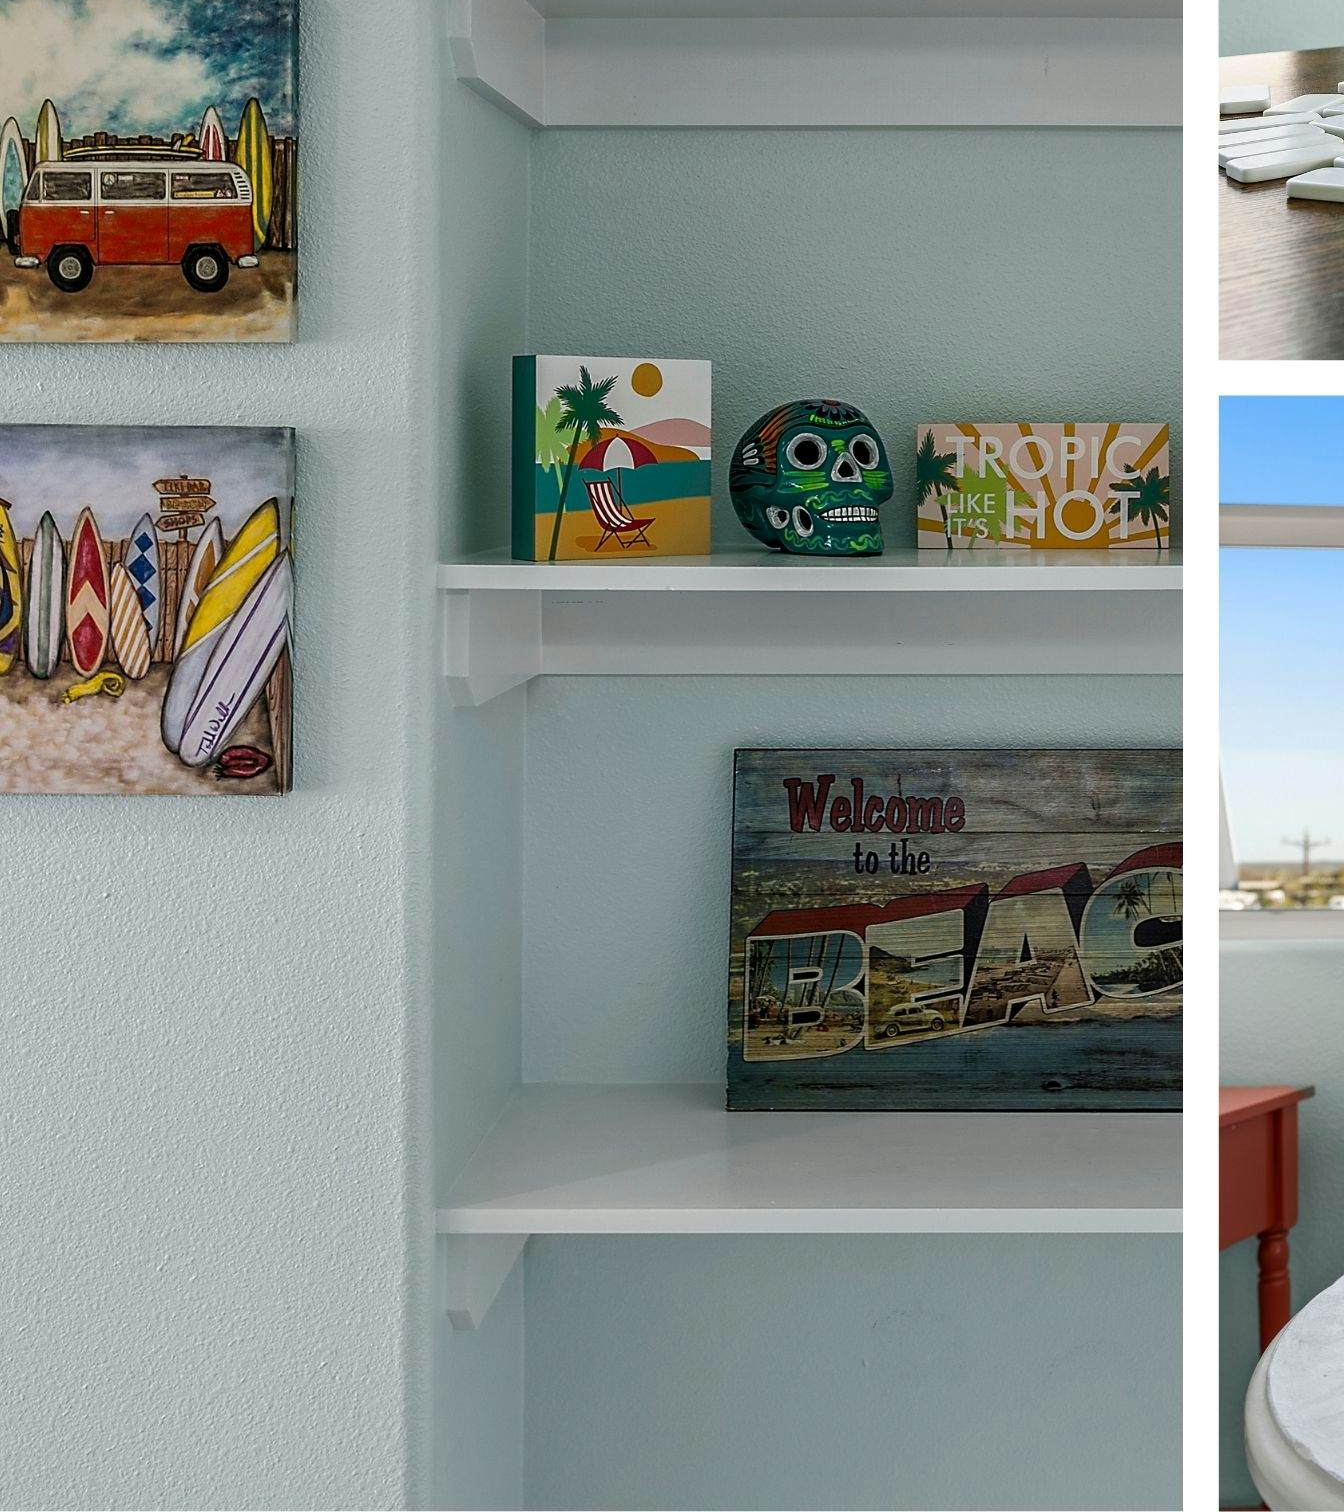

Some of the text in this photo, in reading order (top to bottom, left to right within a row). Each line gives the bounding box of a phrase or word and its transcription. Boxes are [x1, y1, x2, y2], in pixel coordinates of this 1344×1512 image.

[945, 435, 1142, 480] TROPIC
[946, 489, 1141, 540] LIKE HOT
[946, 518, 989, 539] IT'S
[783, 774, 966, 835] Welcome
[853, 838, 931, 876] to the
